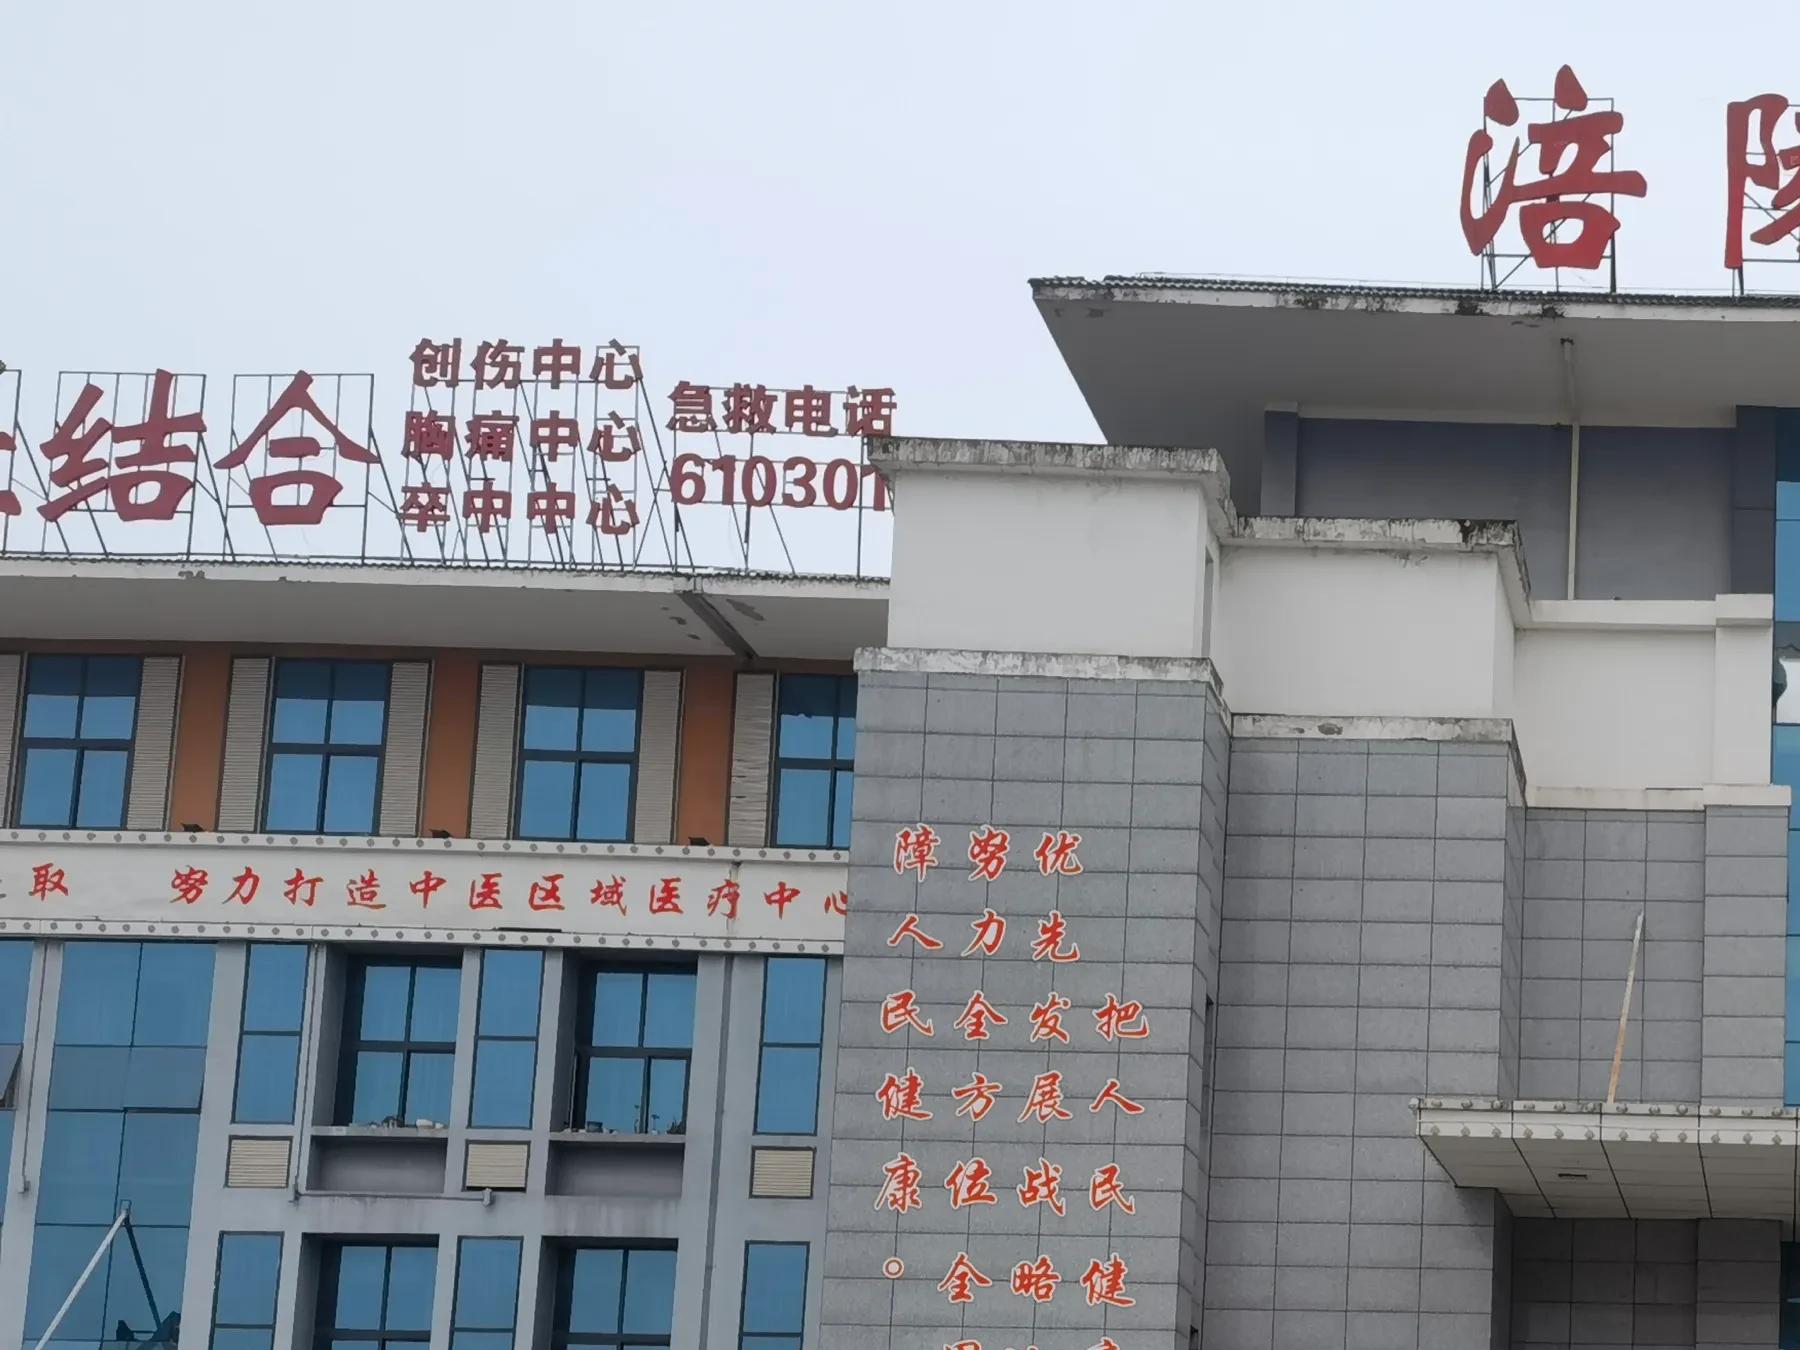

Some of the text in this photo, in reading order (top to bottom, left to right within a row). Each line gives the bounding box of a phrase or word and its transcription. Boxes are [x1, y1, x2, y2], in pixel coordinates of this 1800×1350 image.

[409, 337, 643, 392] 创伤中心
[666, 380, 897, 437] 急救电话
[0, 368, 380, 526] 结合
[402, 409, 641, 466] 胸痛中心
[399, 481, 641, 537] 卒中中心
[0, 862, 849, 921] 取 努力打造中医区域医疗中心
